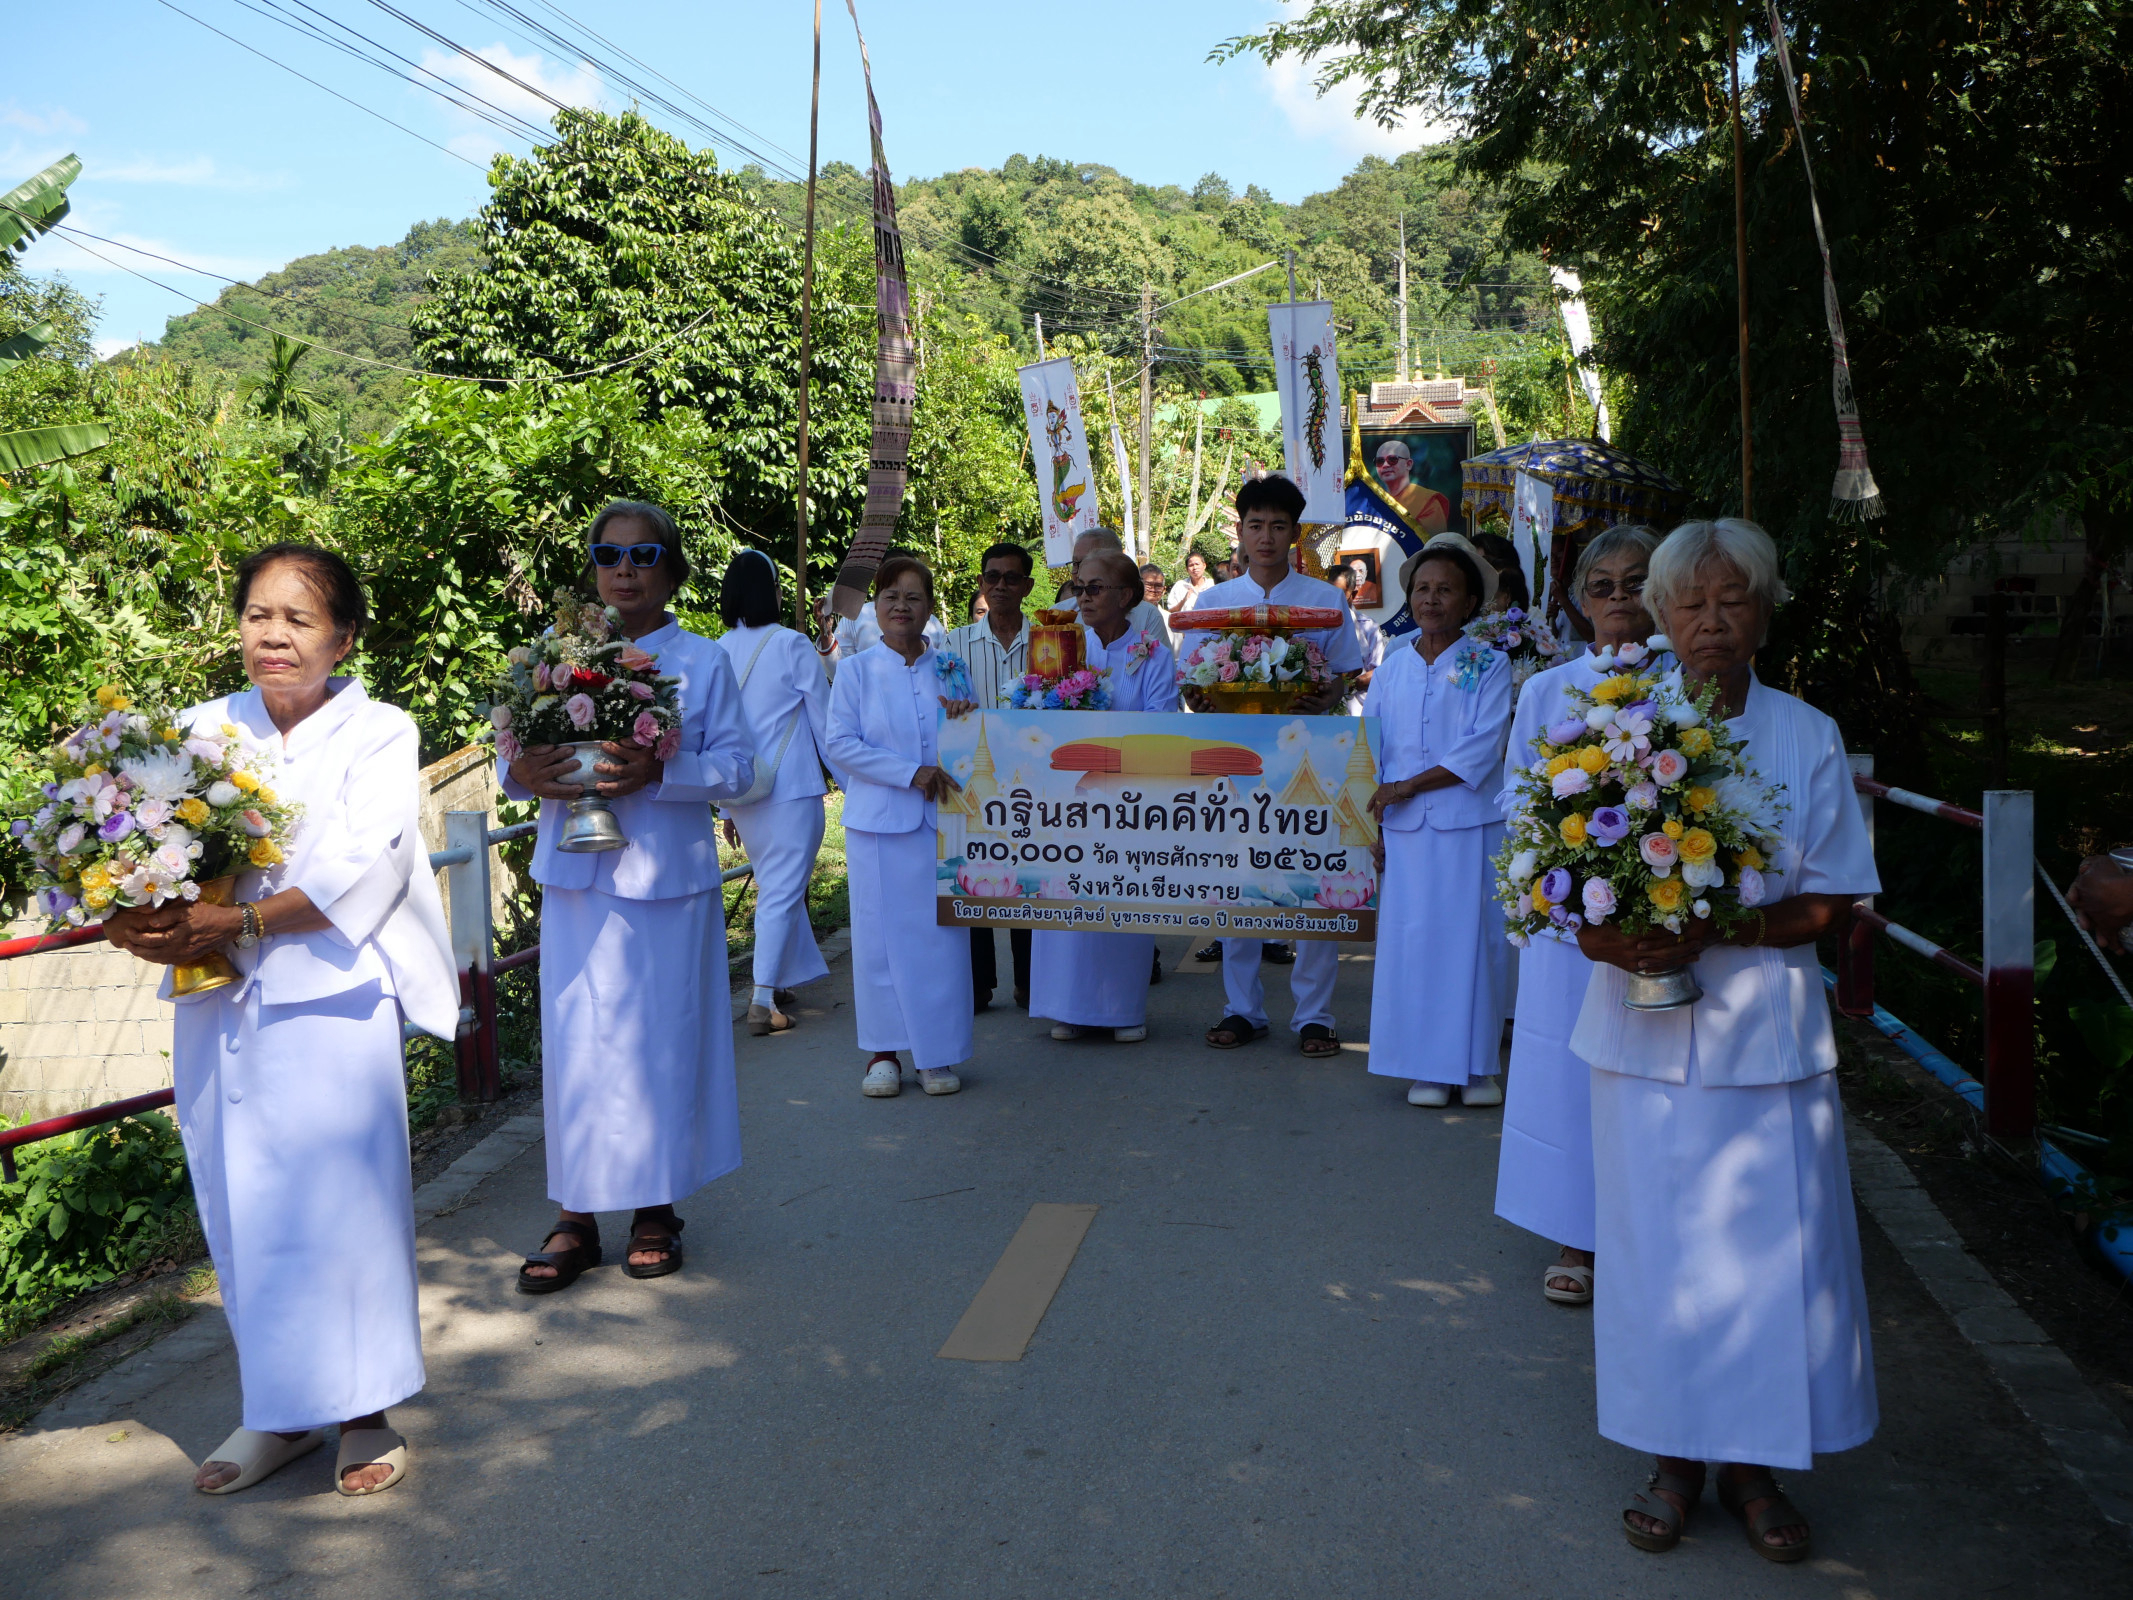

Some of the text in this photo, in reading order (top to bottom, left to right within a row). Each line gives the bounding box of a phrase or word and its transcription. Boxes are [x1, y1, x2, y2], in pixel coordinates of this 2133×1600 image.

[985, 782, 1328, 839] กฐินสามัคคีทั่วไทย
[967, 841, 1347, 873] ๓๐,๐๐๐ วัด พุทธศักราช ๒๕๖๘
[1067, 873, 1240, 901] จังหวัดเชียงราย
[954, 902, 1357, 931] โดย คณะศิษยานุศิษย์ บูชาธรรม ๘๑ ปี หลวงพ่อธัมมชโย
